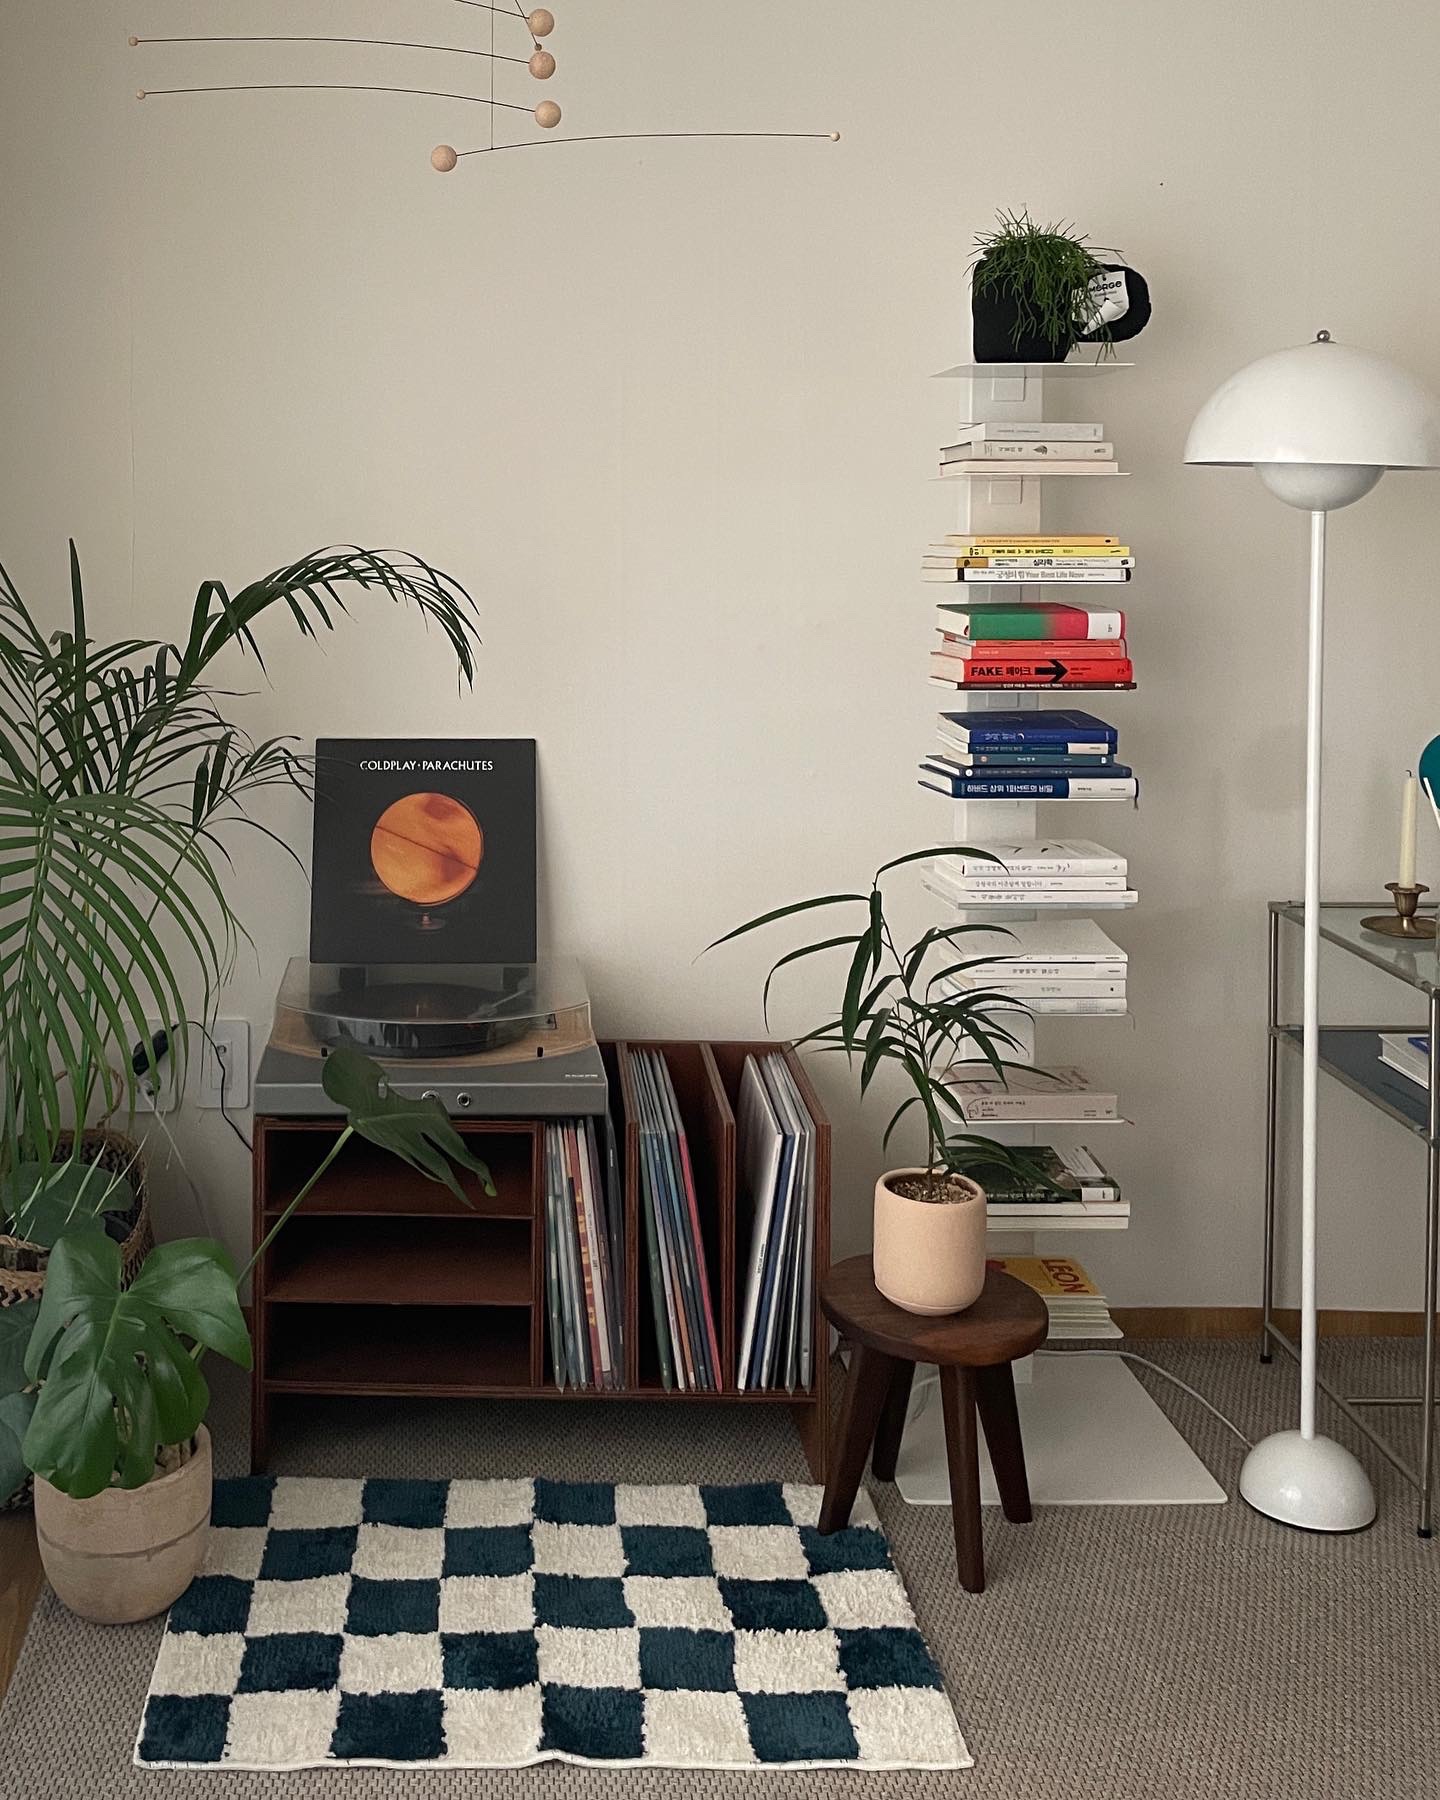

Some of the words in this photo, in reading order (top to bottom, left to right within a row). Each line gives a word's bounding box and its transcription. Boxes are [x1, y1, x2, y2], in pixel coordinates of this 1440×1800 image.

[1033, 558, 1053, 566] 심리학
[1056, 570, 1067, 578] Life
[1069, 570, 1085, 578] Now
[971, 667, 1003, 676] FAKE
[1006, 666, 1032, 676] 페이크
[359, 760, 417, 771] COLDPLAY
[422, 760, 494, 771] PARACHUTES
[967, 785, 988, 793] 하버드
[990, 785, 1004, 793] 상위
[1006, 785, 1038, 793] 1퍼센트의
[1039, 785, 1053, 793] 비밀
[1041, 1259, 1090, 1294] LEON
